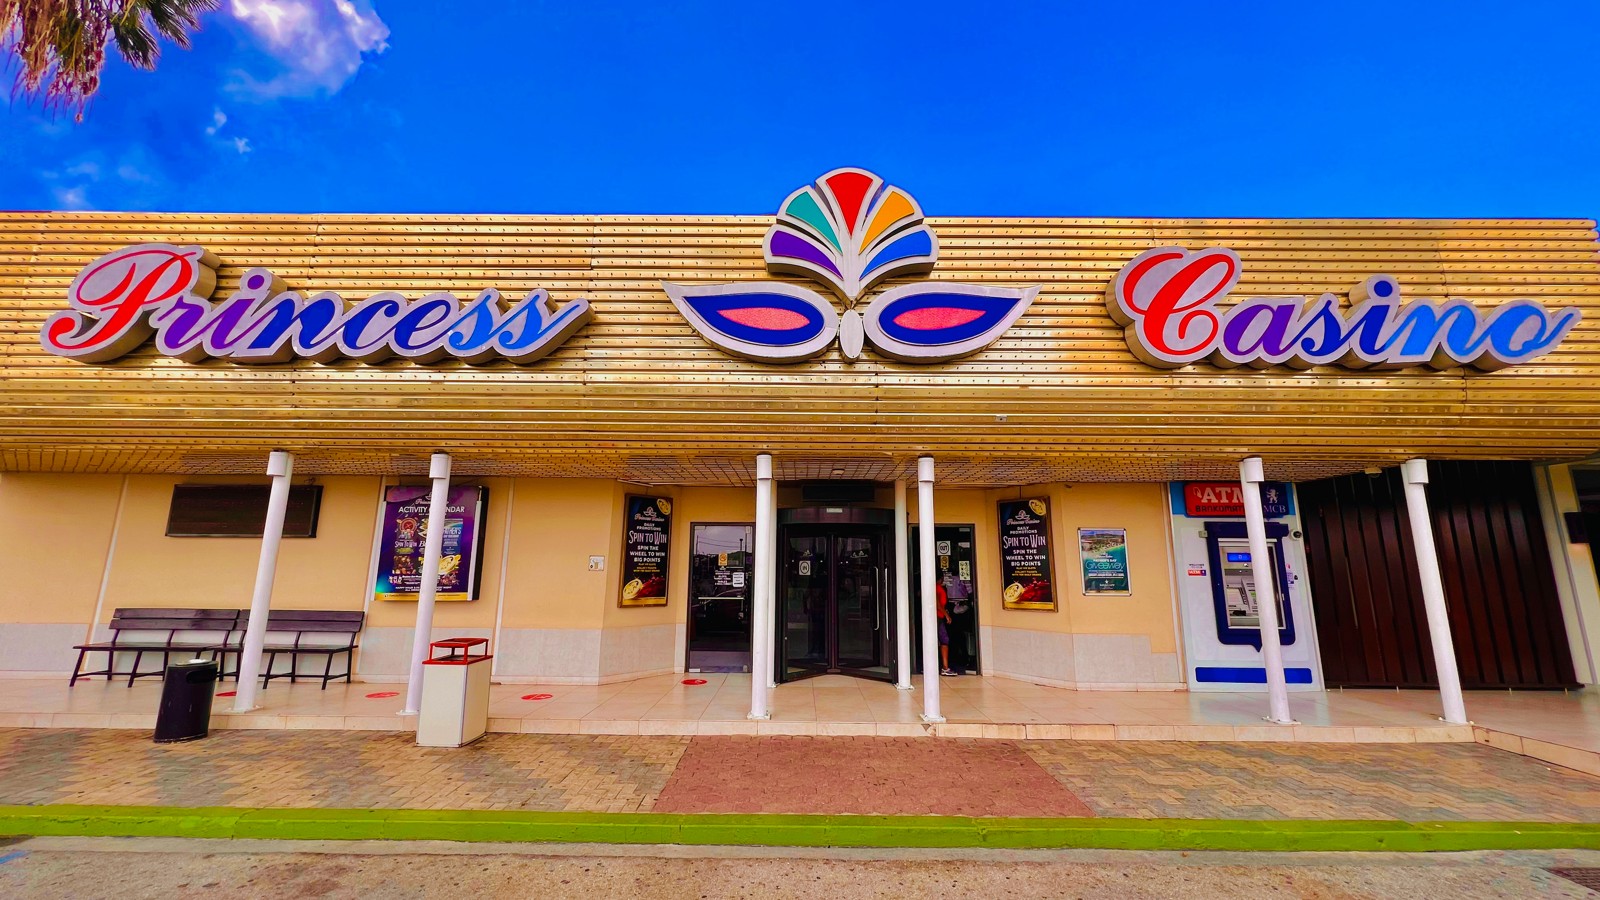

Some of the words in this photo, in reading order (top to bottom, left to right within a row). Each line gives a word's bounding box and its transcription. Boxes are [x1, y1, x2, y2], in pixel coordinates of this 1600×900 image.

[46, 248, 583, 352] Princess
[1121, 250, 1578, 358] Casino
[1263, 504, 1286, 513] MCB
